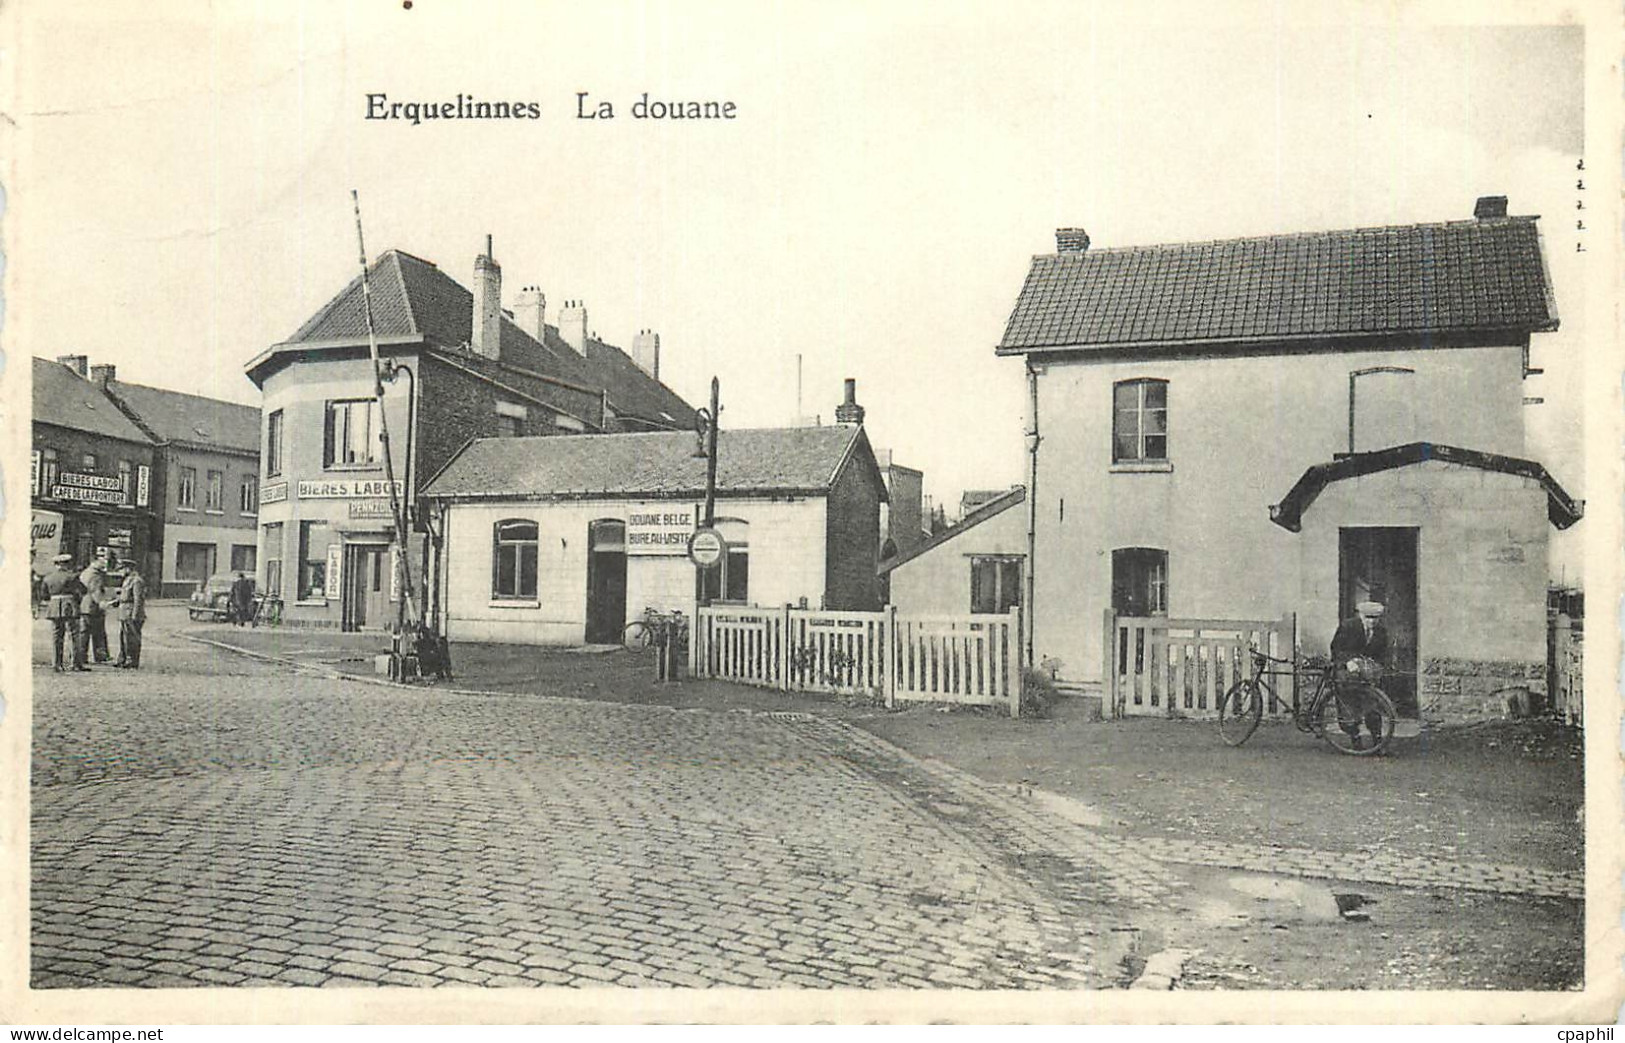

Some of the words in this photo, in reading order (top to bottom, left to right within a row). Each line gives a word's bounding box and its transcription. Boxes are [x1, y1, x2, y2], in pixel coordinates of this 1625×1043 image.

[299, 482, 348, 496] BIERES
[354, 481, 403, 495] LABOR
[629, 514, 661, 526] DOUANE
[330, 551, 339, 593] LABOR
